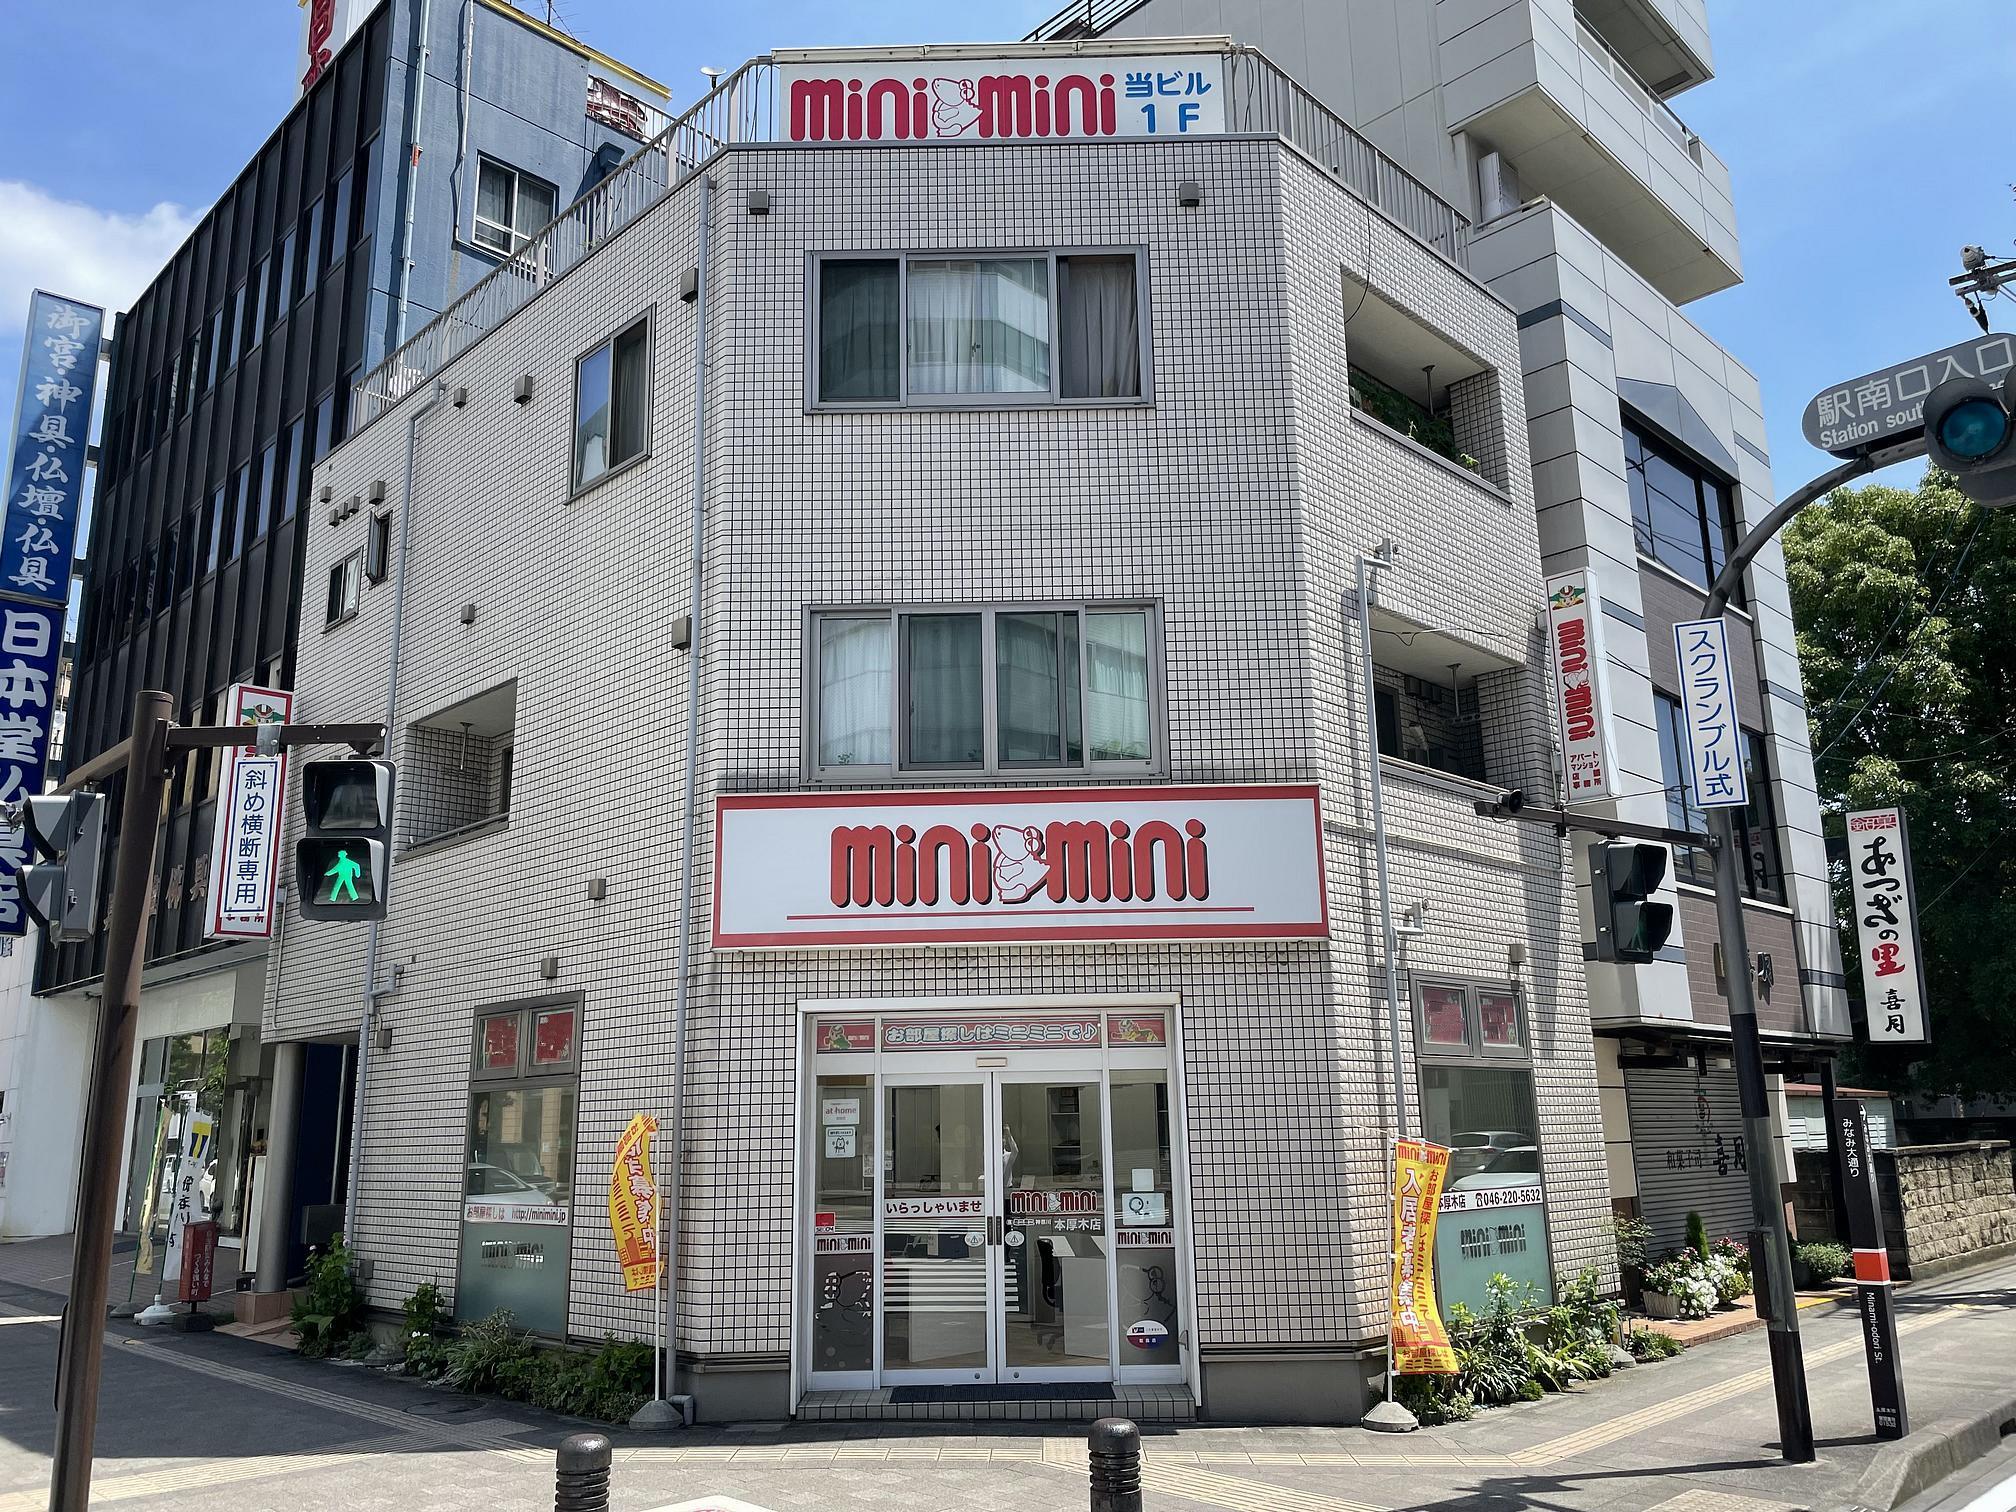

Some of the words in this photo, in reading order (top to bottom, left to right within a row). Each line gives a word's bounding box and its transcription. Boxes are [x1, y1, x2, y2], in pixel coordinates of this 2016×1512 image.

[790, 78, 928, 141] mini
[978, 74, 1117, 138] mini
[1125, 71, 1212, 98] 当ビル
[1816, 337, 2014, 428] 駅南口入口
[1820, 418, 1879, 448] Station
[1886, 400, 1925, 428] sout
[1557, 618, 1588, 674] mini
[1564, 685, 1596, 742] mini
[1689, 630, 1734, 797] スクランブル式
[1570, 751, 1599, 763] アパート
[1571, 760, 1600, 771] マンション
[235, 769, 268, 905] 斜め横断専用
[830, 822, 994, 909] mini
[1046, 818, 1211, 903] mini
[1861, 835, 1906, 978] あつぎの里
[1880, 988, 1906, 1035] 喜月
[1842, 1118, 1861, 1178] みなみ大通り
[886, 1200, 982, 1214] いらっしゃいませ
[1011, 1191, 1048, 1213] mini
[1060, 1191, 1097, 1212] mini
[1483, 1189, 1541, 1206] 046-220-5632
[817, 1238, 841, 1252] mini
[848, 1237, 872, 1251] mini
[1054, 1218, 1101, 1231] 本厚木店
[1117, 1231, 1141, 1245] mini
[1149, 1231, 1172, 1244] mini
